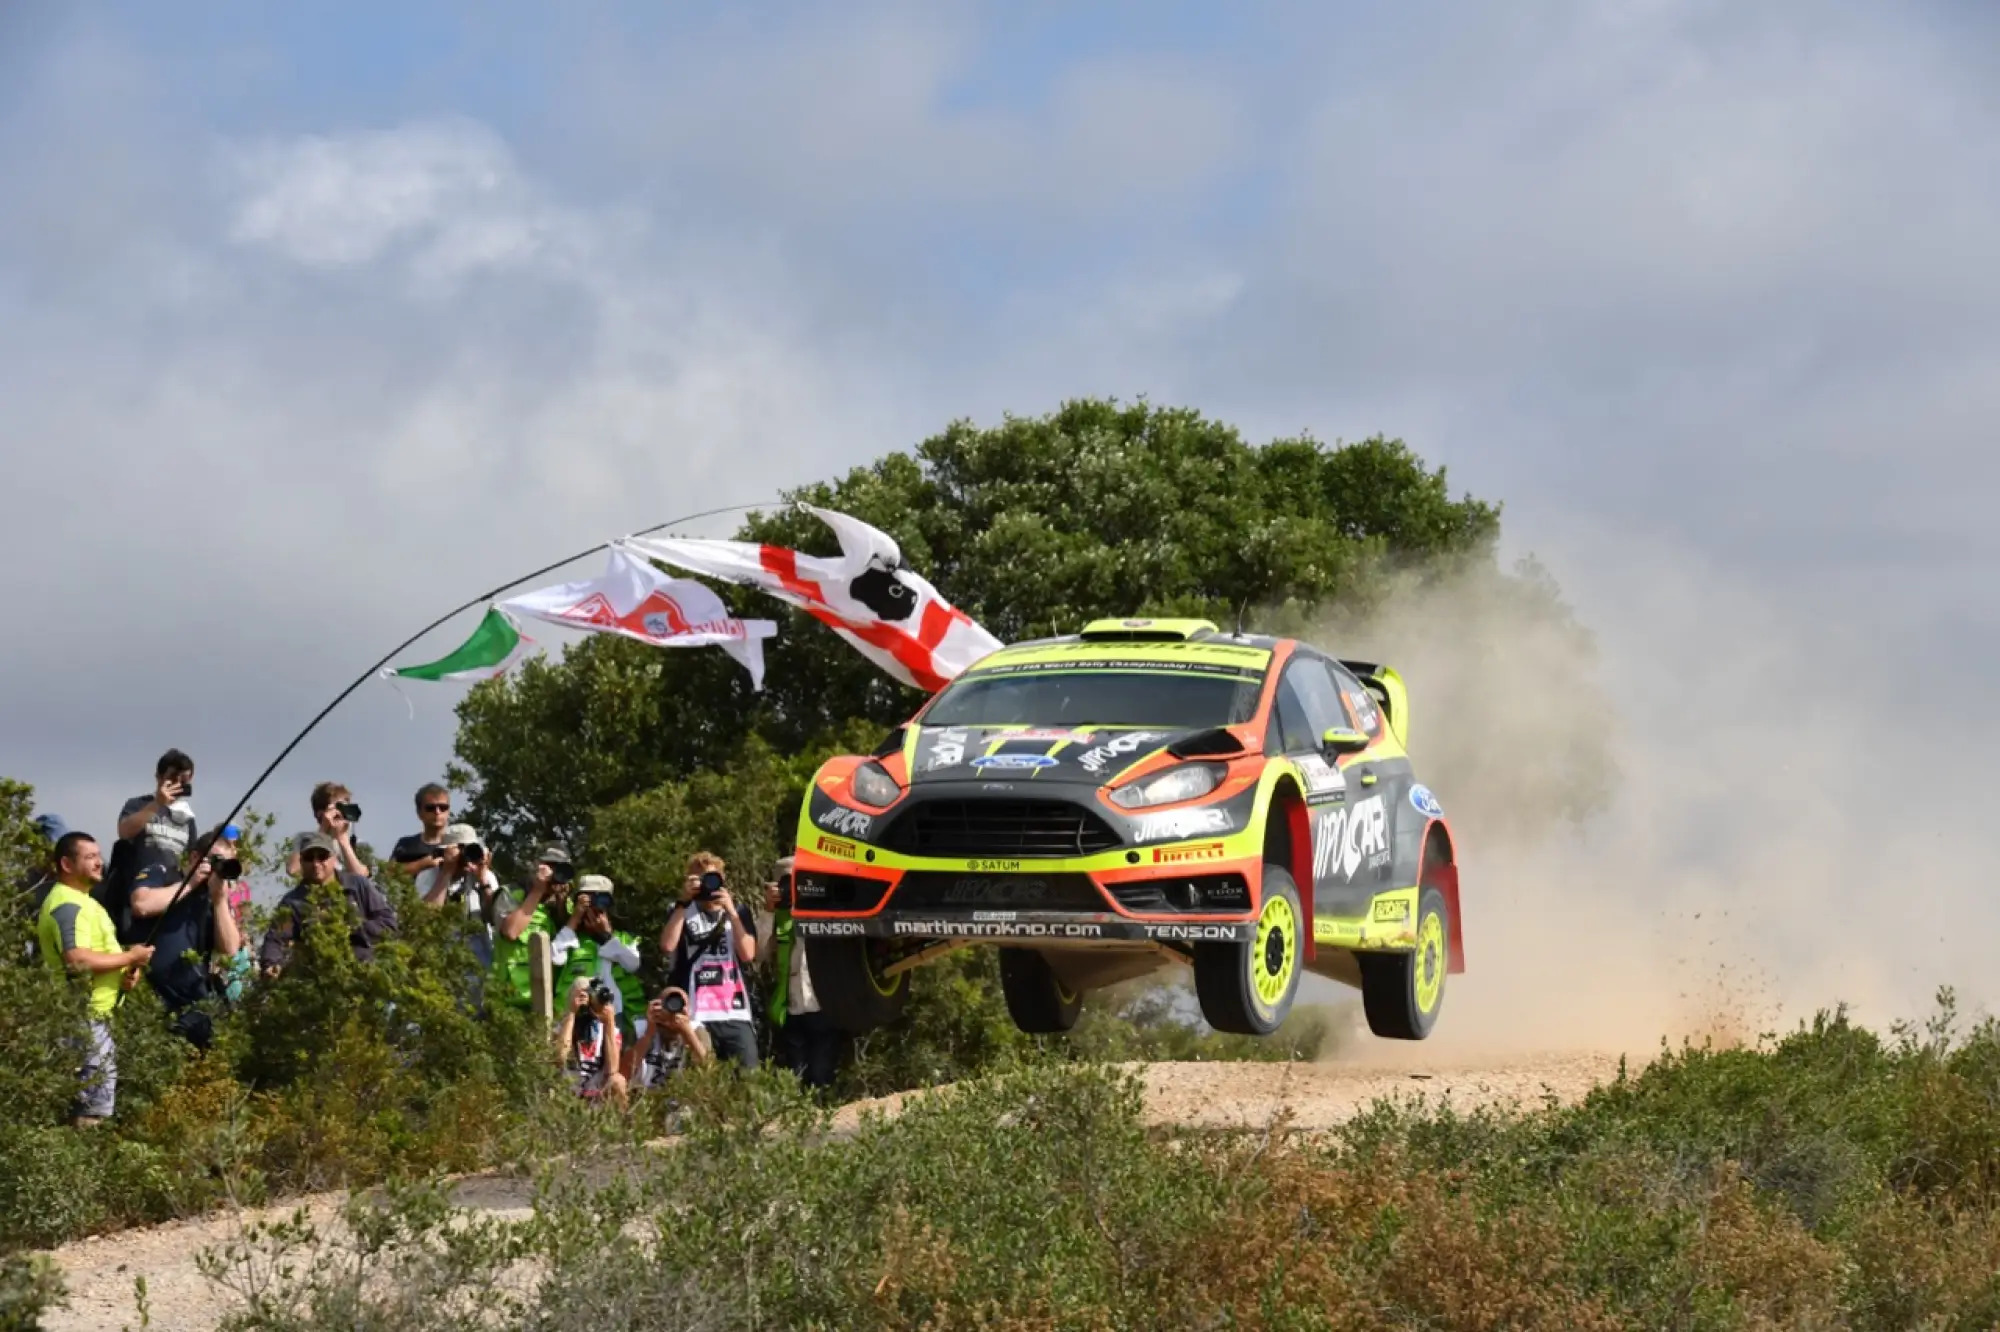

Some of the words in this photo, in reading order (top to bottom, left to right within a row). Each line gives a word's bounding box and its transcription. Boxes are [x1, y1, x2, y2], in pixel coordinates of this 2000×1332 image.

[817, 836, 856, 860] PIRELLI
[1153, 843, 1224, 863] PIRELLI
[981, 860, 1020, 870] SATUM
[799, 922, 865, 935] TENSON
[1144, 925, 1237, 939] TENSON
